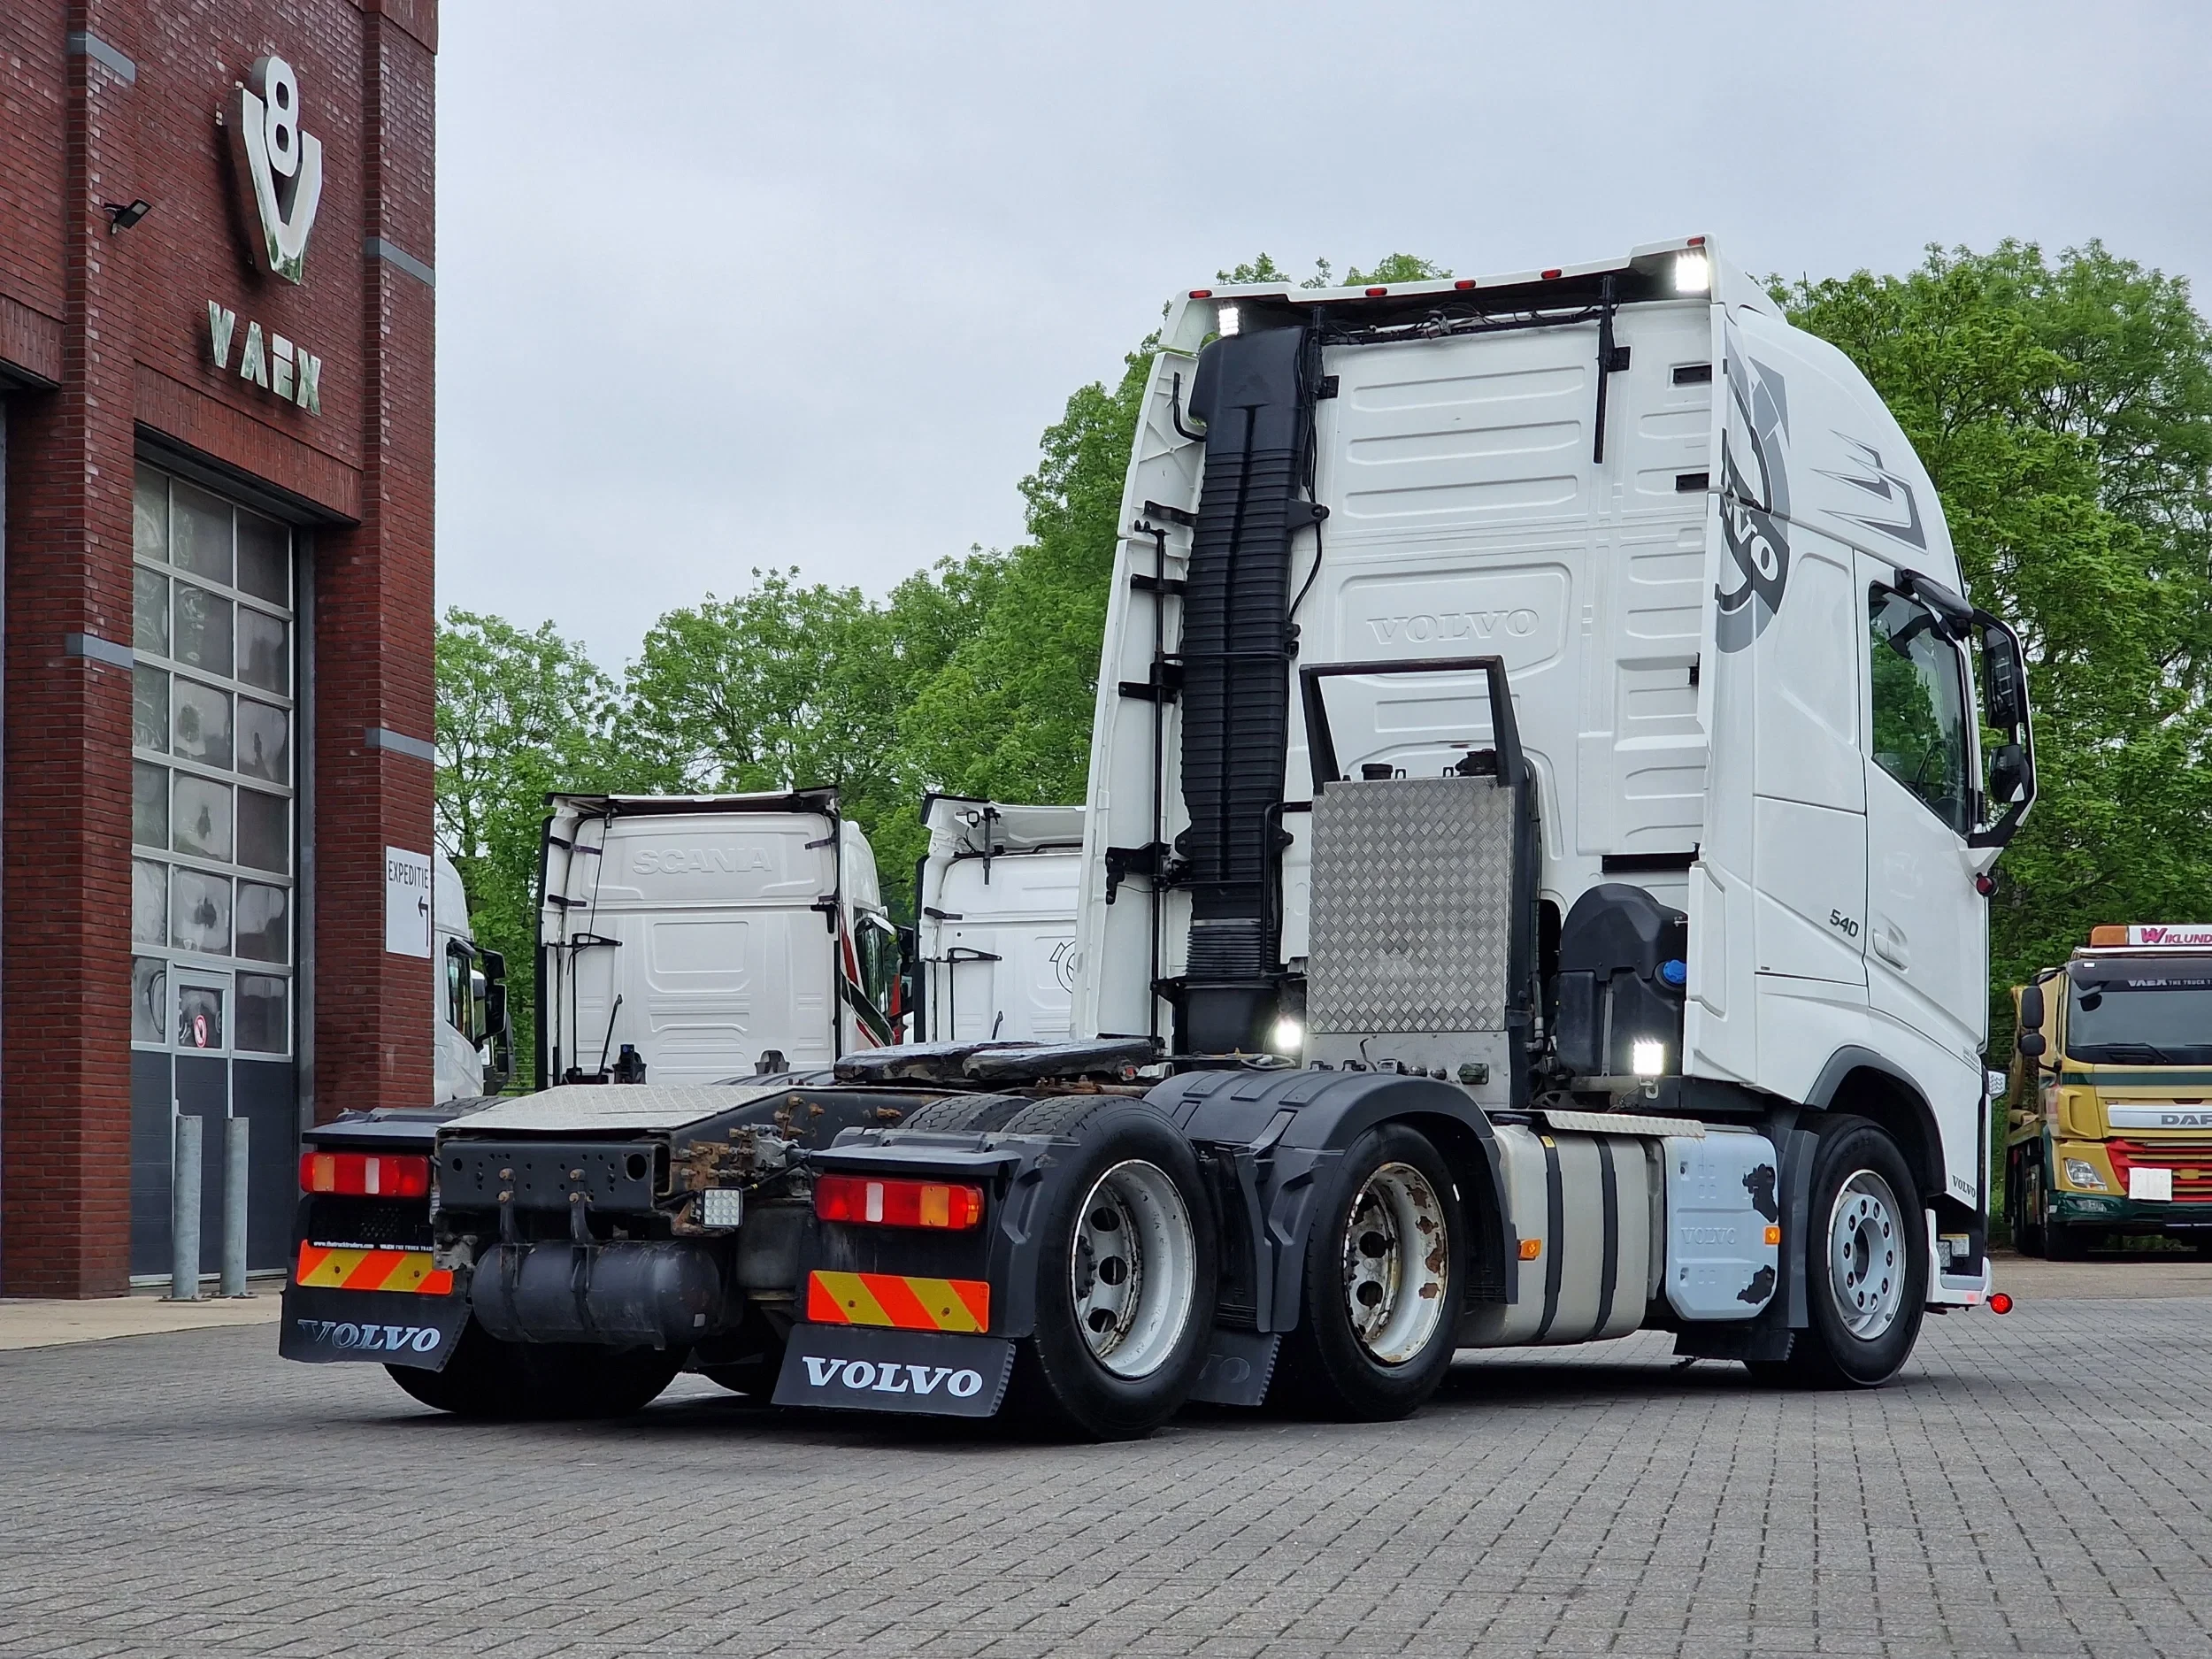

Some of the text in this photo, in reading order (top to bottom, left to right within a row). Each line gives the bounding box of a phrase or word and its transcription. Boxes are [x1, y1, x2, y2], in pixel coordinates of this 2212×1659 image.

[1366, 608, 1540, 645] VOLVO
[388, 860, 429, 889] EXPEDITIE
[633, 847, 772, 875] SCANIA
[1829, 908, 1859, 938] 540
[2161, 1114, 2212, 1125] DAF
[1952, 1174, 1976, 1198] VOLVO
[1680, 1227, 1737, 1245] VOLVO
[297, 1319, 441, 1352] VOLVO
[803, 1356, 983, 1398] VOLVO
